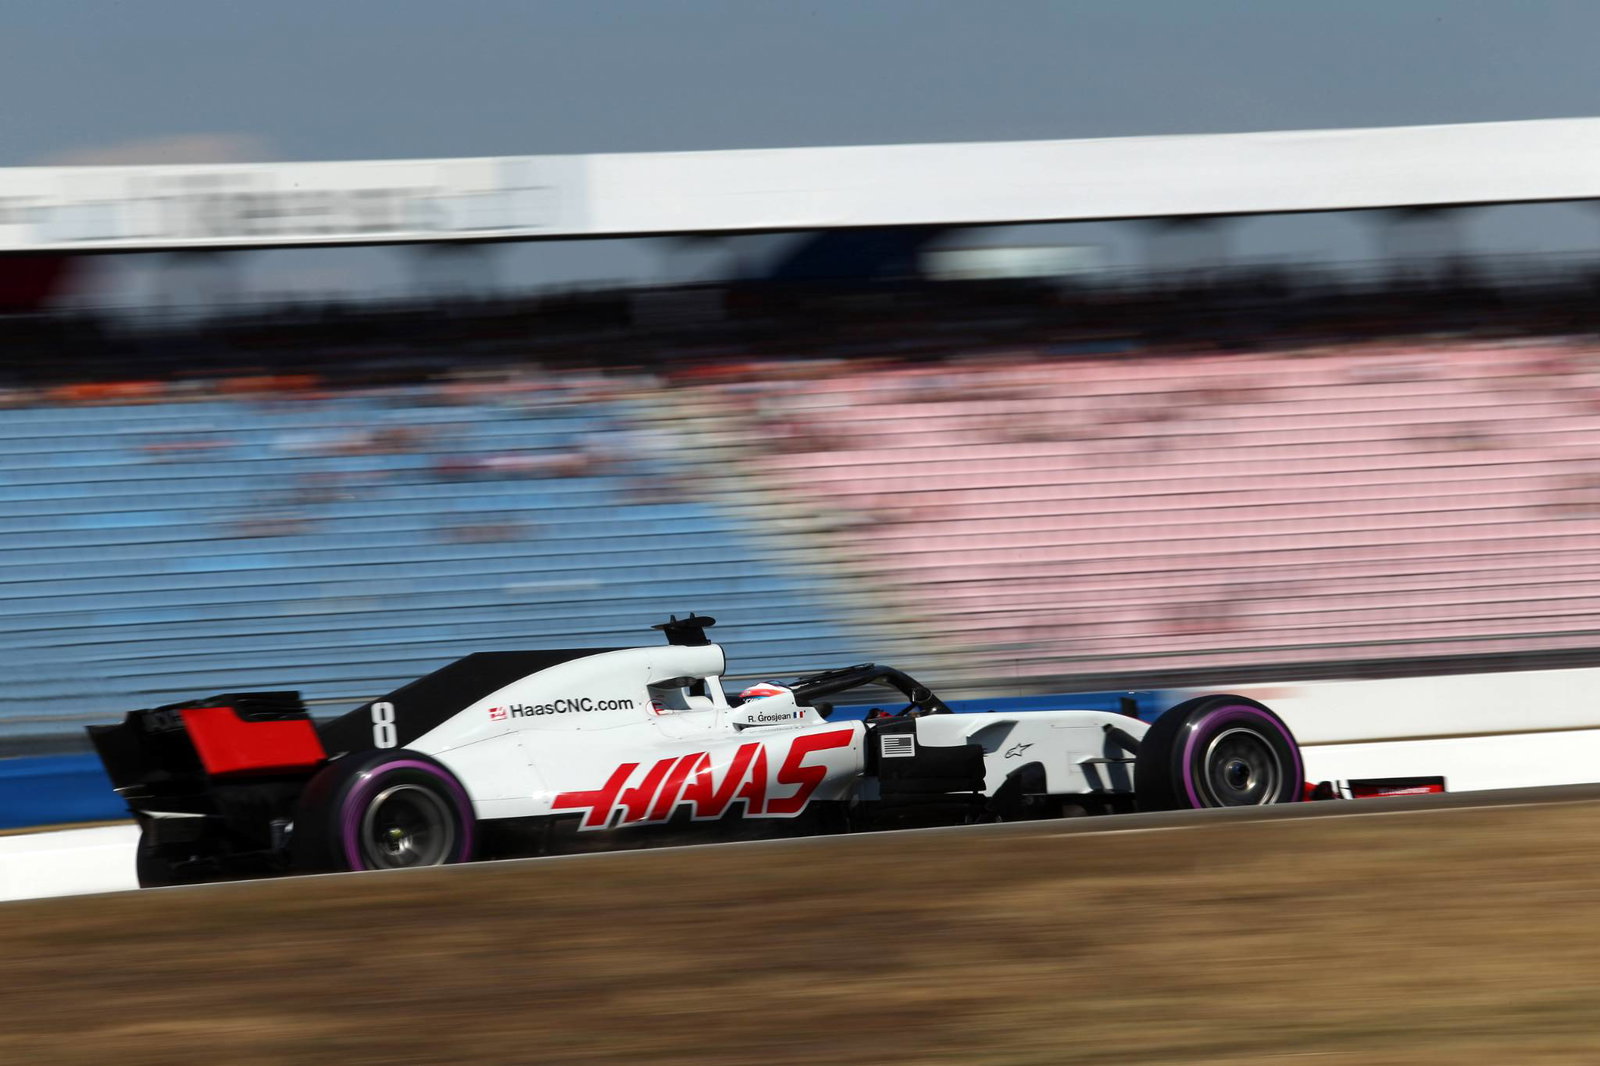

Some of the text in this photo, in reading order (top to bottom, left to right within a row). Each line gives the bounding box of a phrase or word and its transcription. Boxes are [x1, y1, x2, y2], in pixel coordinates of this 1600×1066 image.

[371, 698, 397, 749] 8
[509, 698, 634, 718] HaasCNC.com
[747, 712, 791, 723] R. Grosjean
[552, 728, 854, 827] HAAS
